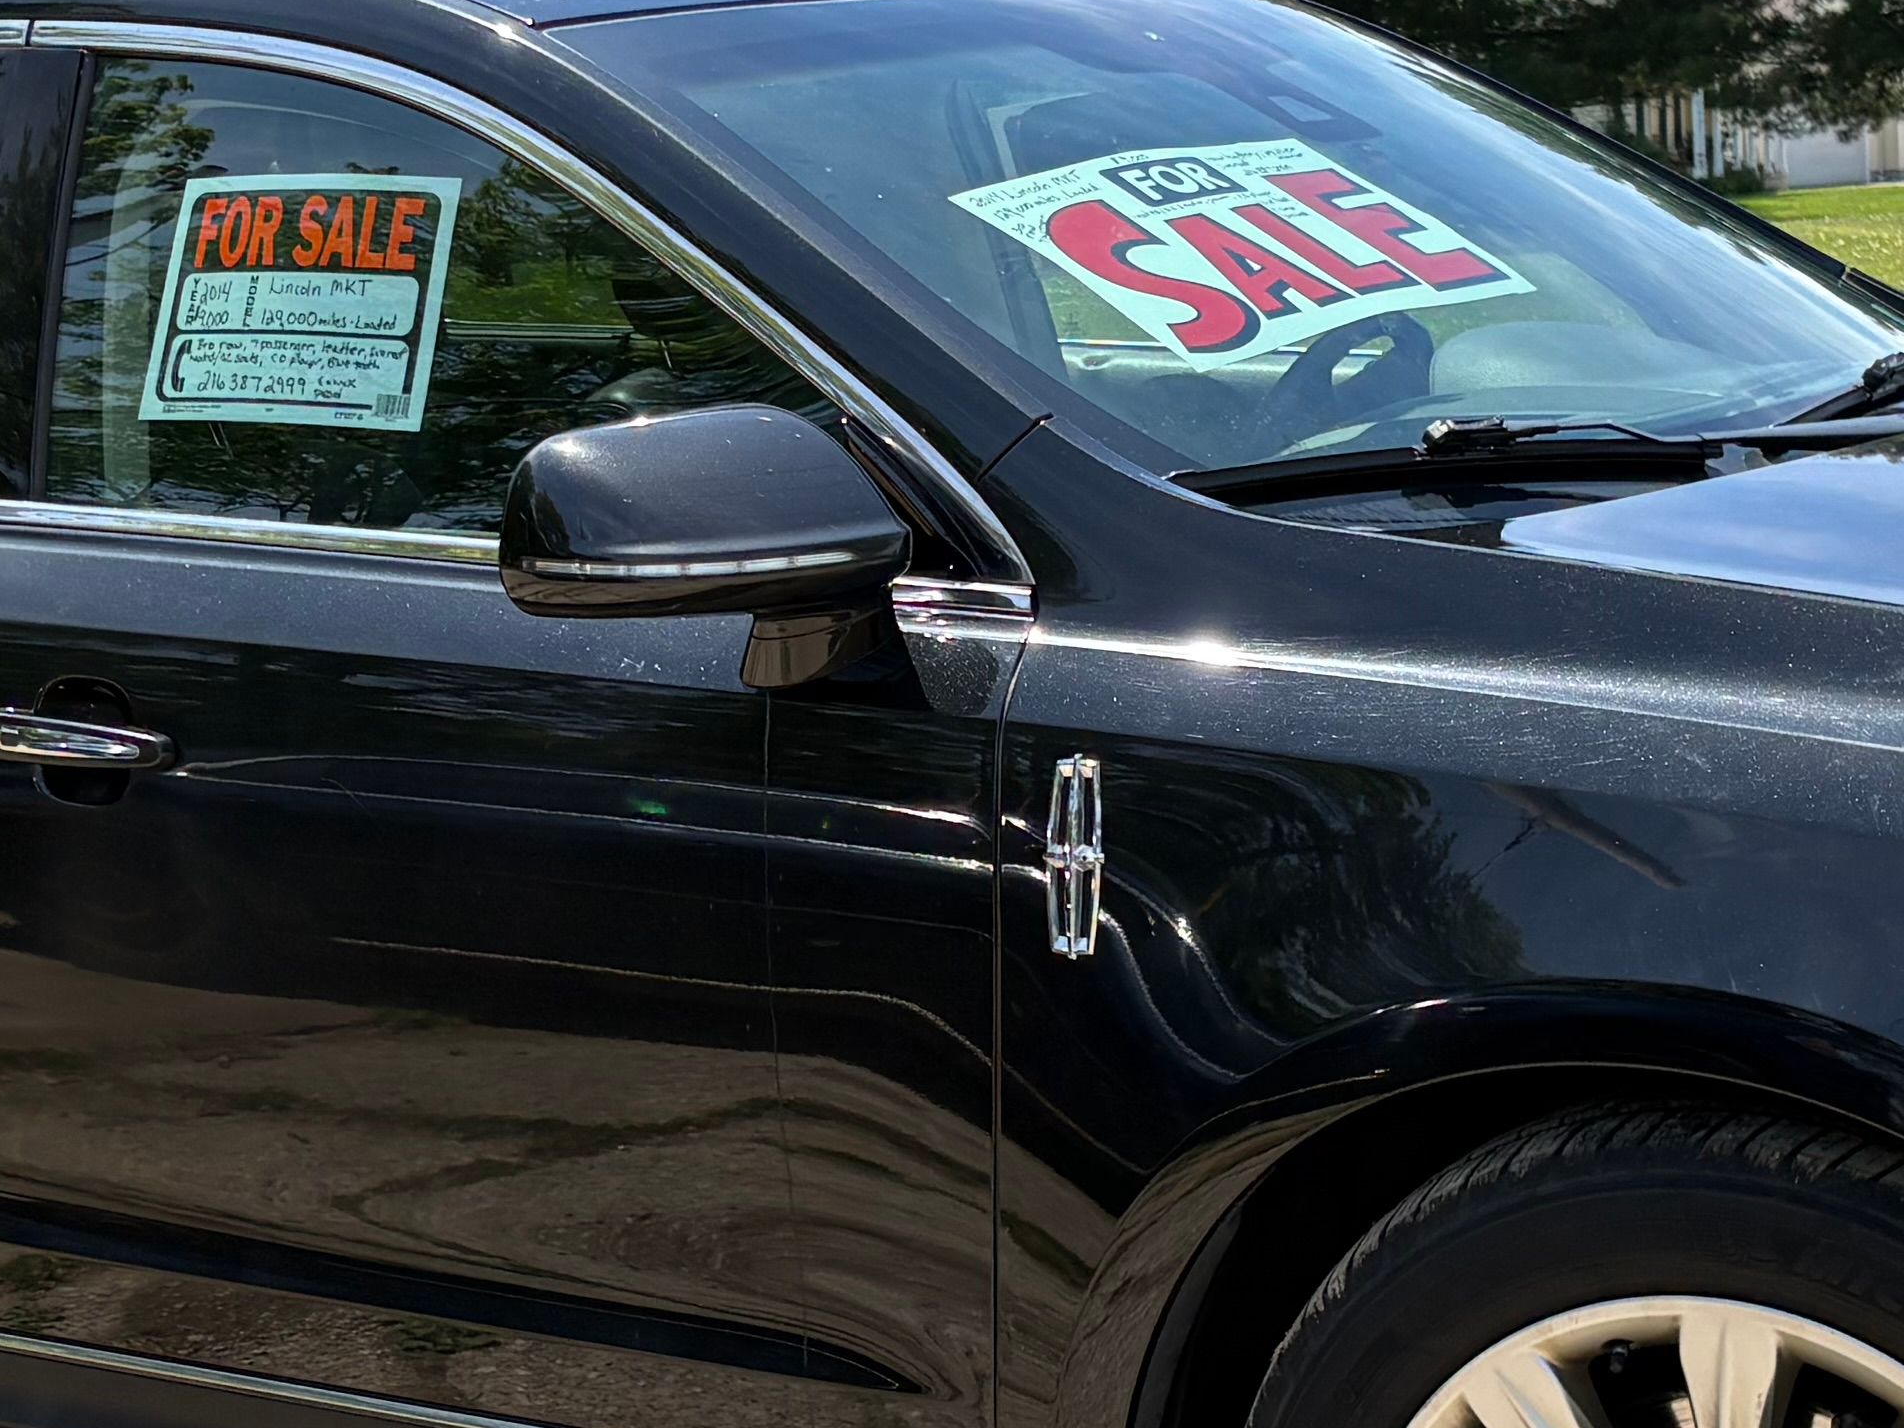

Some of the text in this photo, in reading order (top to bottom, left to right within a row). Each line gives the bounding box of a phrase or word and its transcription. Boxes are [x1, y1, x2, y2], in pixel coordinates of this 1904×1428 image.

[1117, 162, 1231, 201] FOR
[193, 194, 426, 270] FOR SALE
[1046, 168, 1512, 354] SALE
[184, 277, 201, 326] YEAR
[199, 280, 233, 306] 2014
[242, 275, 260, 328] MODEL
[269, 276, 373, 297] Lincoln MKT
